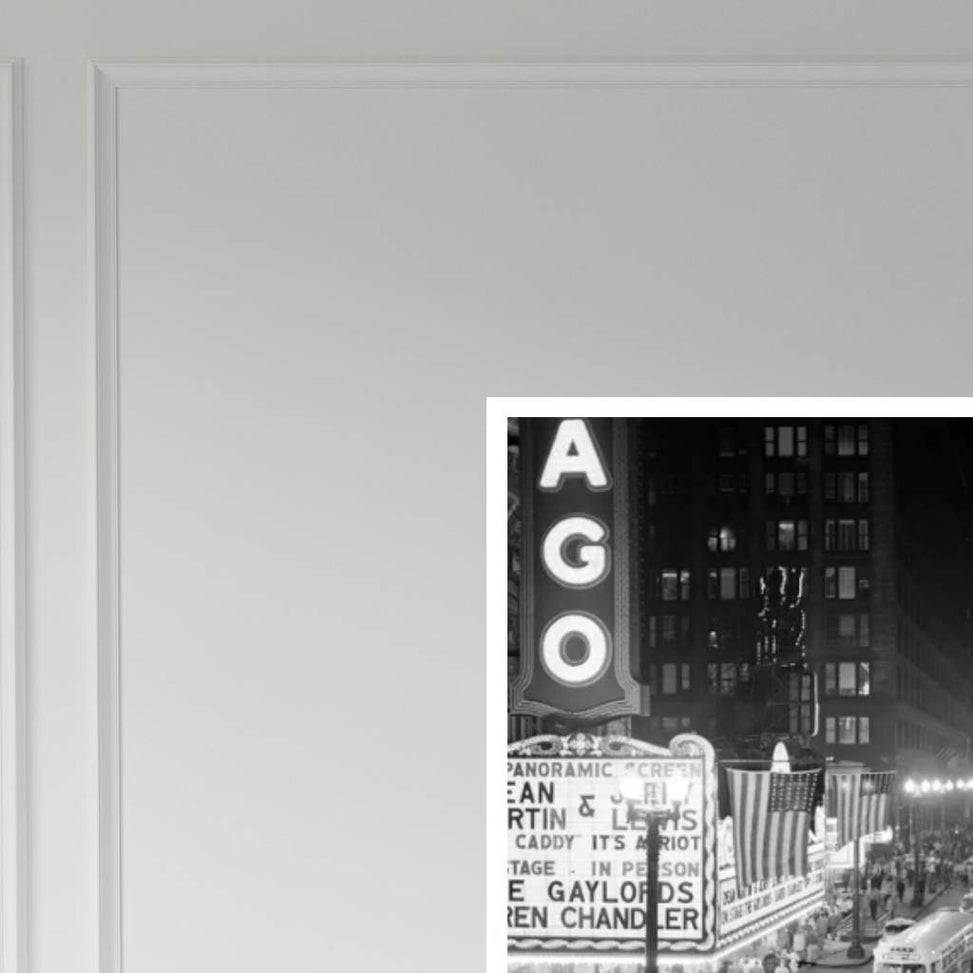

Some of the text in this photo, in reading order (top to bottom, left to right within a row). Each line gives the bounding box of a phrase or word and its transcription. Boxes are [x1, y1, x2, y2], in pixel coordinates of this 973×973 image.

[539, 418, 609, 683] AGO
[507, 762, 613, 778] PANORAMIC
[507, 781, 554, 804] EAN
[578, 794, 596, 818] &
[508, 807, 698, 831] RTIN LES
[514, 834, 575, 850] CADDY
[659, 834, 701, 851] RIOT
[507, 860, 556, 876] TAGE
[591, 861, 612, 877] IN
[622, 861, 700, 877] PESON
[508, 879, 525, 902] E
[560, 905, 700, 931] CHANDER
